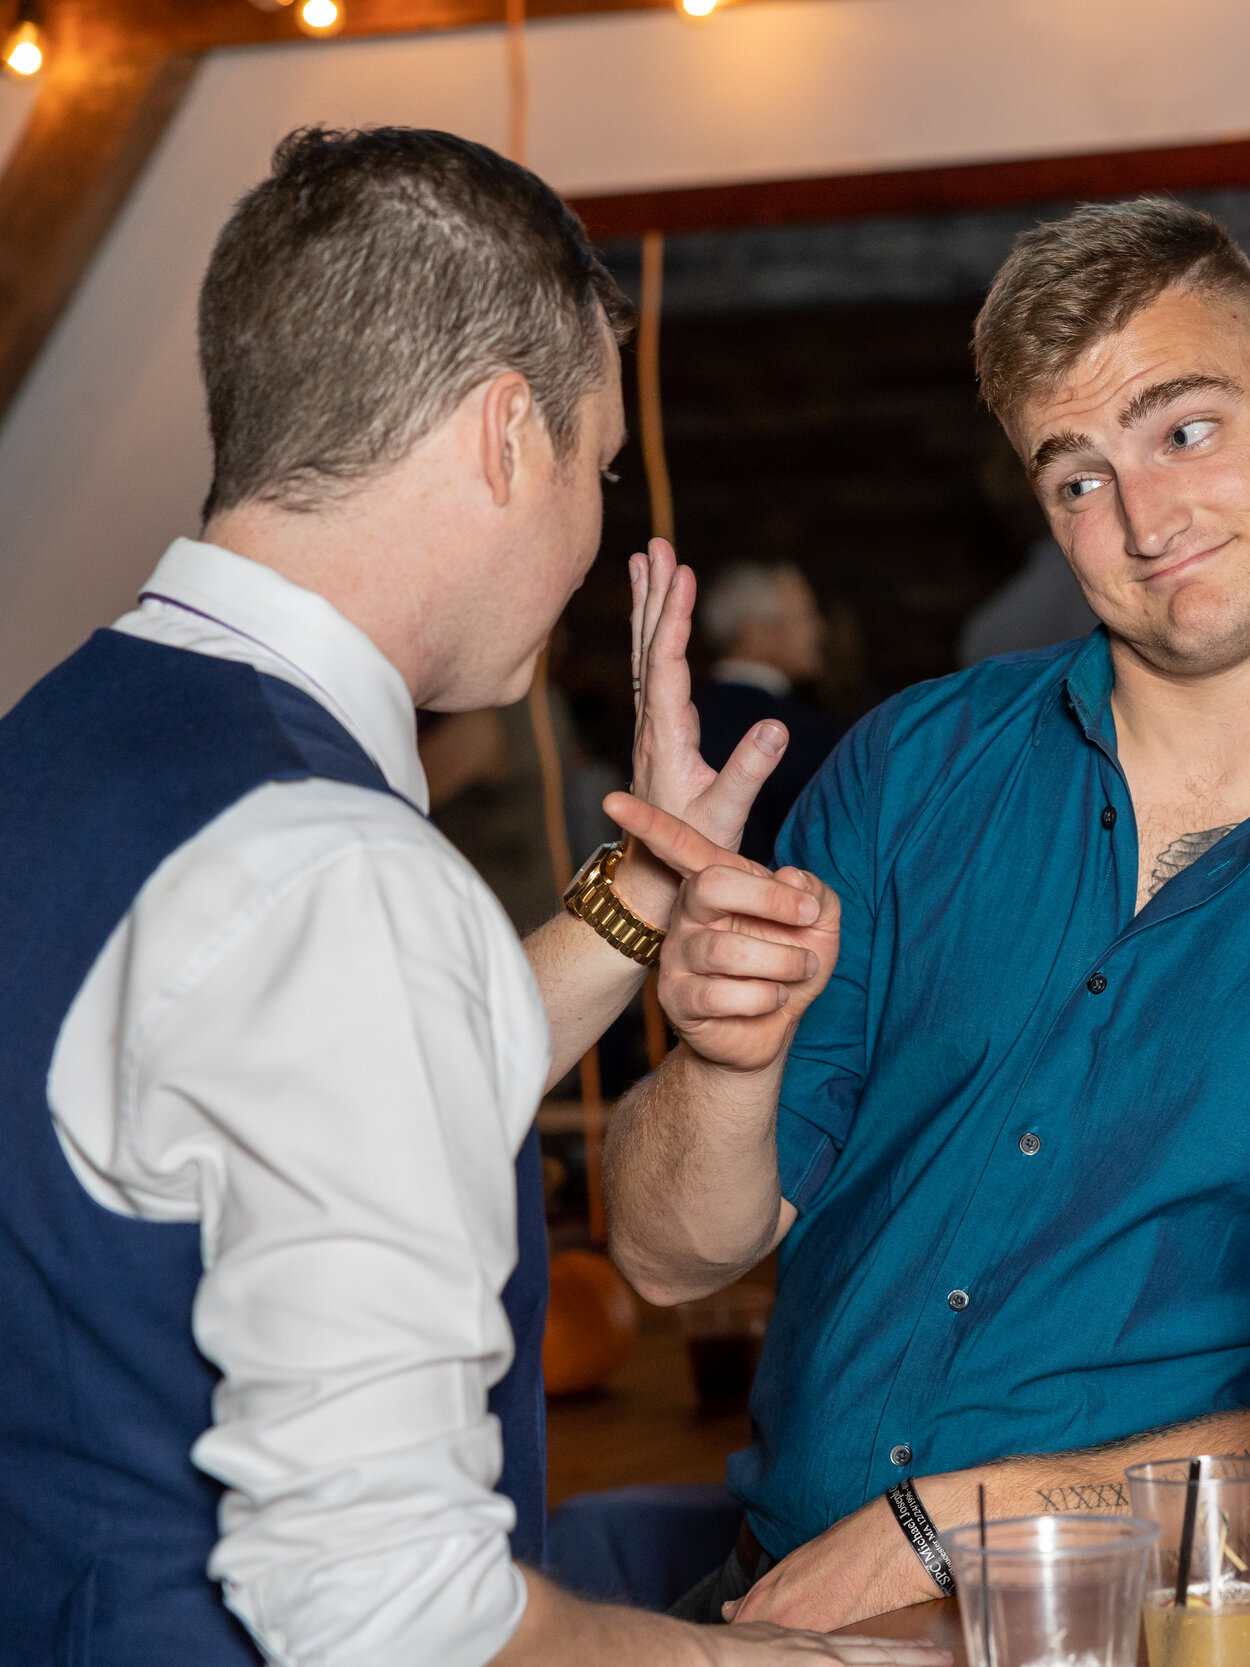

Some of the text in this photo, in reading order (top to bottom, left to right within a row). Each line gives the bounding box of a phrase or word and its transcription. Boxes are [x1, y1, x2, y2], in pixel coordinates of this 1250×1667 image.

[890, 1490, 910, 1520] Joseph
[903, 1519, 936, 1564] Michael
[924, 1524, 936, 1541] MA
[929, 1562, 951, 1586] SPC
